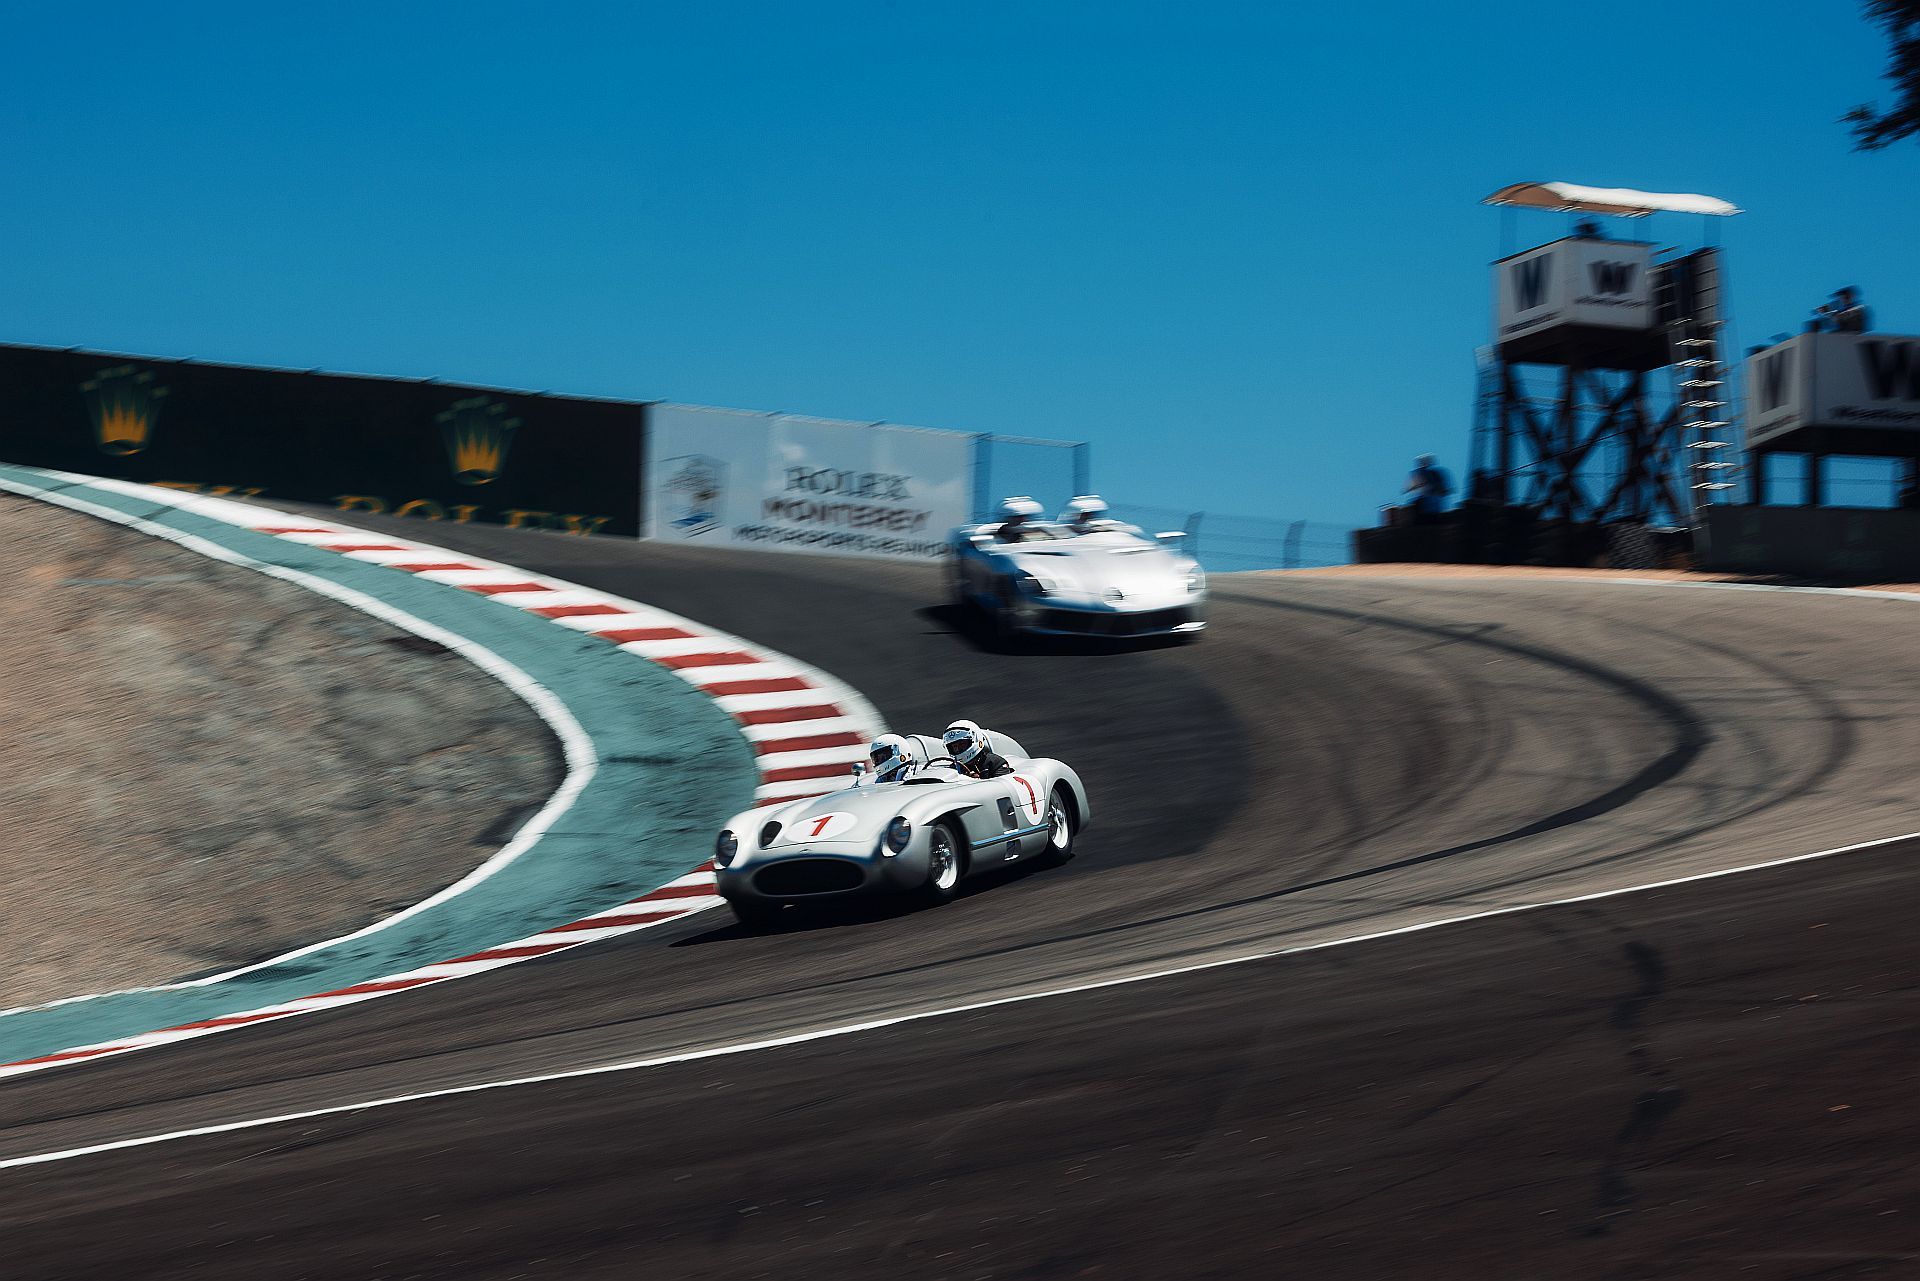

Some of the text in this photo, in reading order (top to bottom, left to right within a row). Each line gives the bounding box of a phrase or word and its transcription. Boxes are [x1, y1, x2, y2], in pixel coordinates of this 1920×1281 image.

[784, 466, 913, 501] ROLEX
[760, 497, 932, 534] MONTEREY
[1013, 775, 1037, 815] 1
[809, 815, 834, 837] 1
